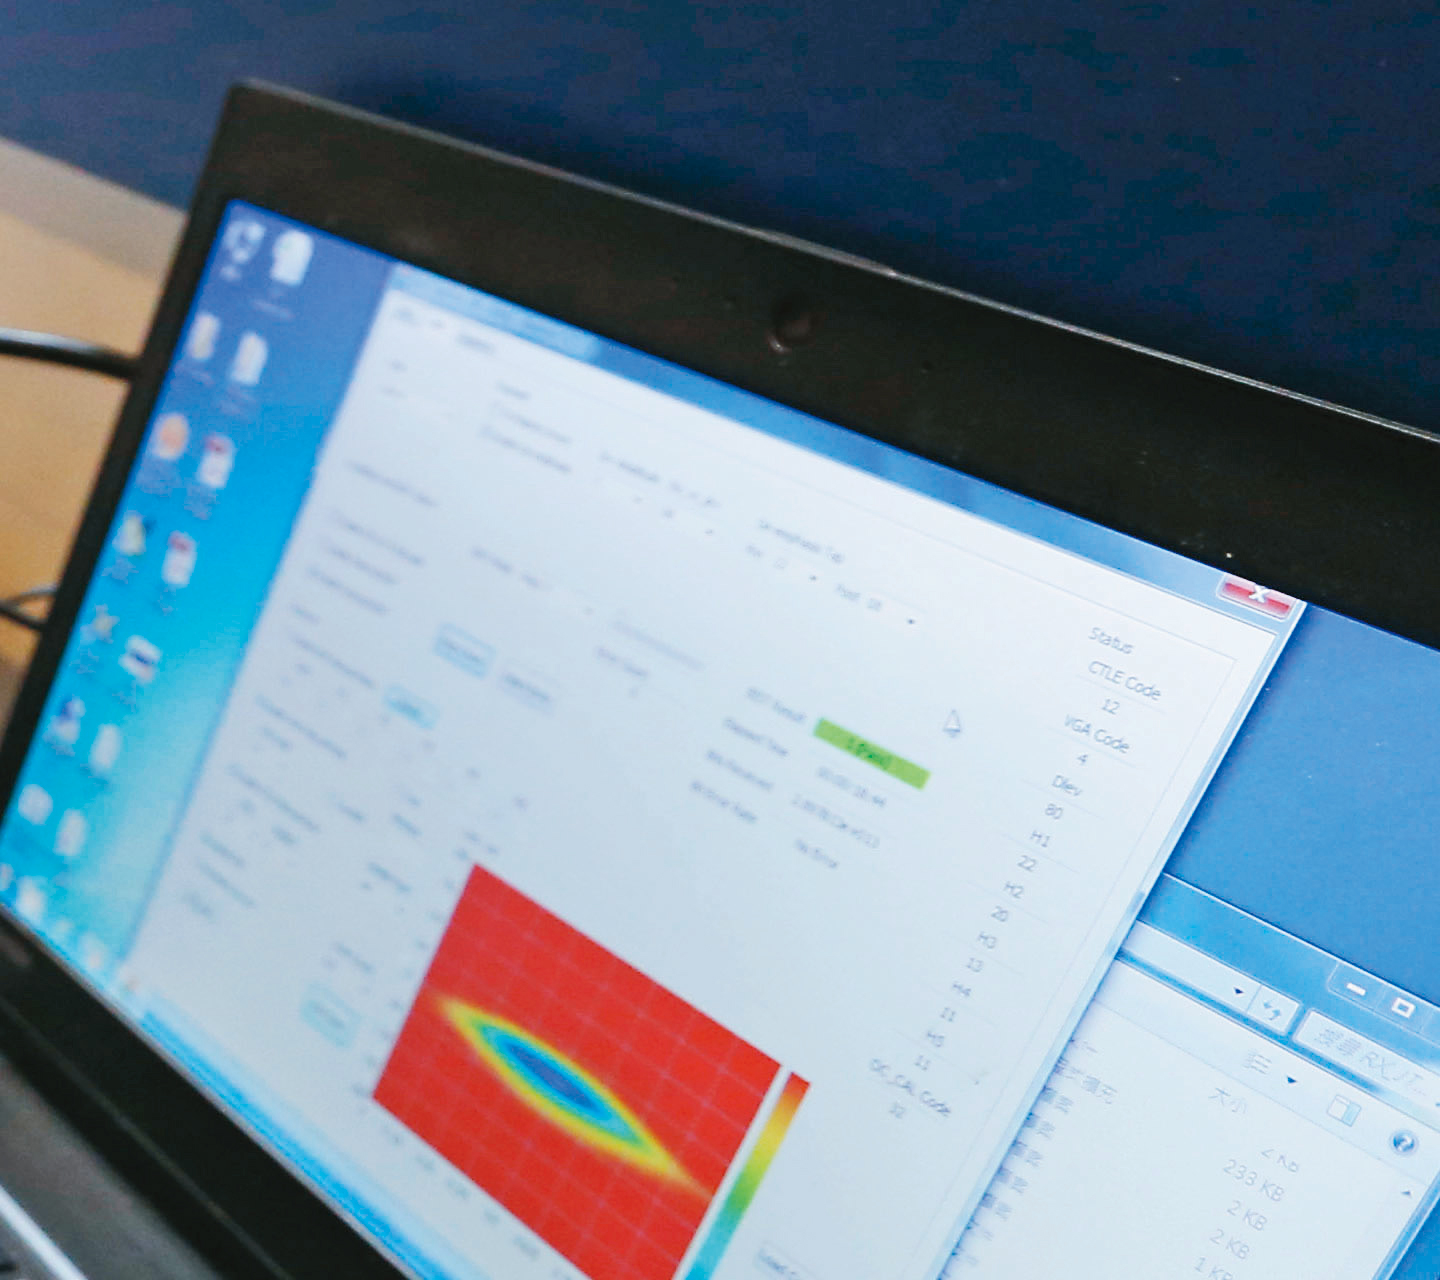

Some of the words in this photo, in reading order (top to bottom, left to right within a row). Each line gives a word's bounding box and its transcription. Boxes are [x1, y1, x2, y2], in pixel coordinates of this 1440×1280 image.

[1088, 626, 1134, 654] Status
[1087, 660, 1125, 685] CTLE
[1124, 676, 1162, 701] Code
[1063, 713, 1092, 737] VGA
[1093, 728, 1131, 755] Code
[1030, 830, 1051, 848] H1
[1003, 881, 1025, 900] H2
[1223, 1158, 1259, 1187] 233
[1259, 1179, 1285, 1202] KB
[1226, 1199, 1242, 1217] 2
[1242, 1208, 1268, 1231] KB
[1209, 1228, 1225, 1245] 2
[1225, 1236, 1250, 1260] KB
[1194, 1256, 1207, 1273] 1
